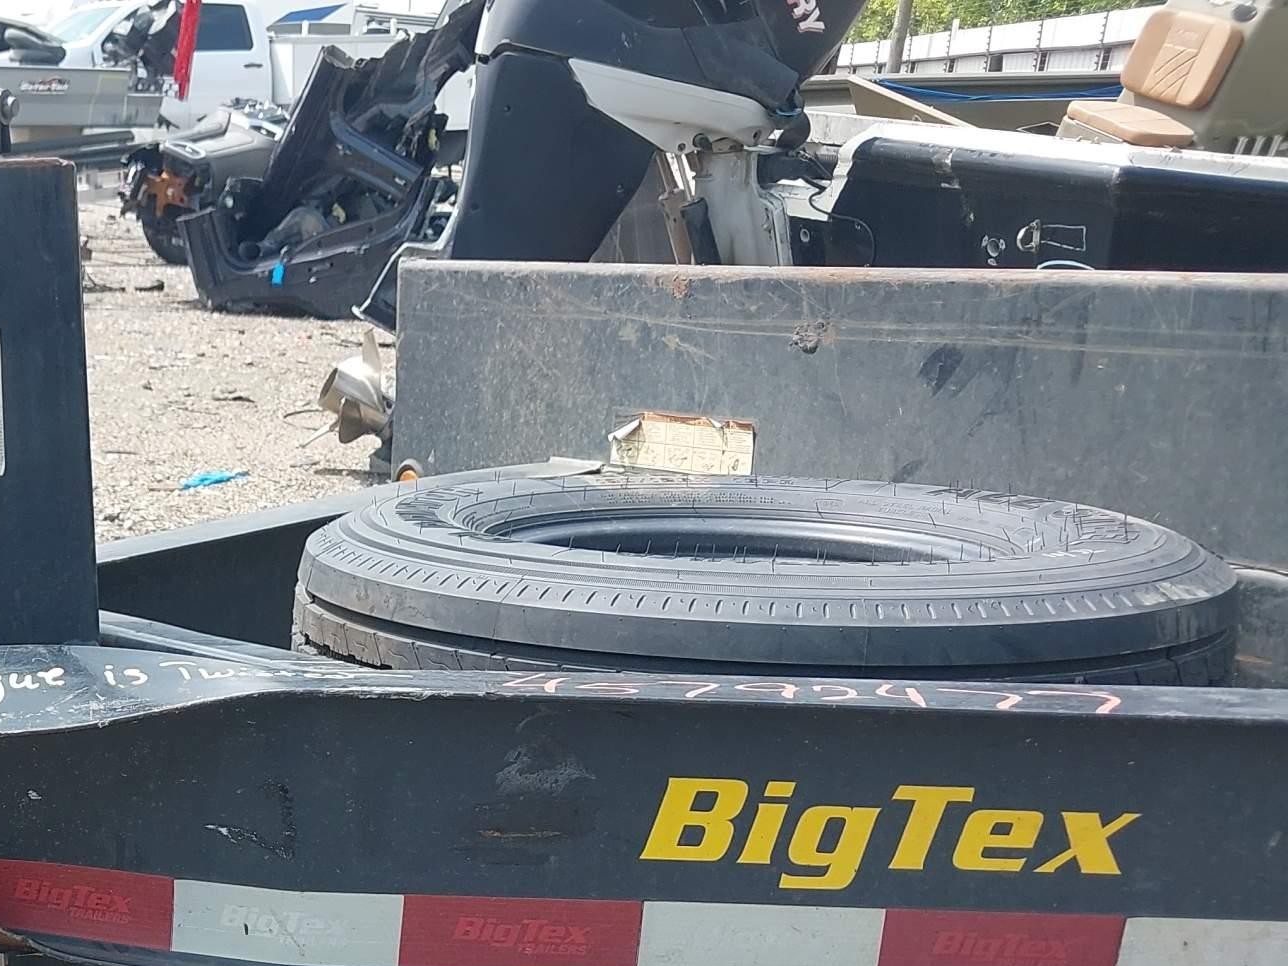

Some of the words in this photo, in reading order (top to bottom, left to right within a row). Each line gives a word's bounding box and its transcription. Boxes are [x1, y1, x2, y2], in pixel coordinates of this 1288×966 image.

[103, 664, 147, 687] is
[639, 776, 1142, 890] BigTex
[13, 879, 132, 913] BigTex
[452, 916, 591, 947] BigTex
